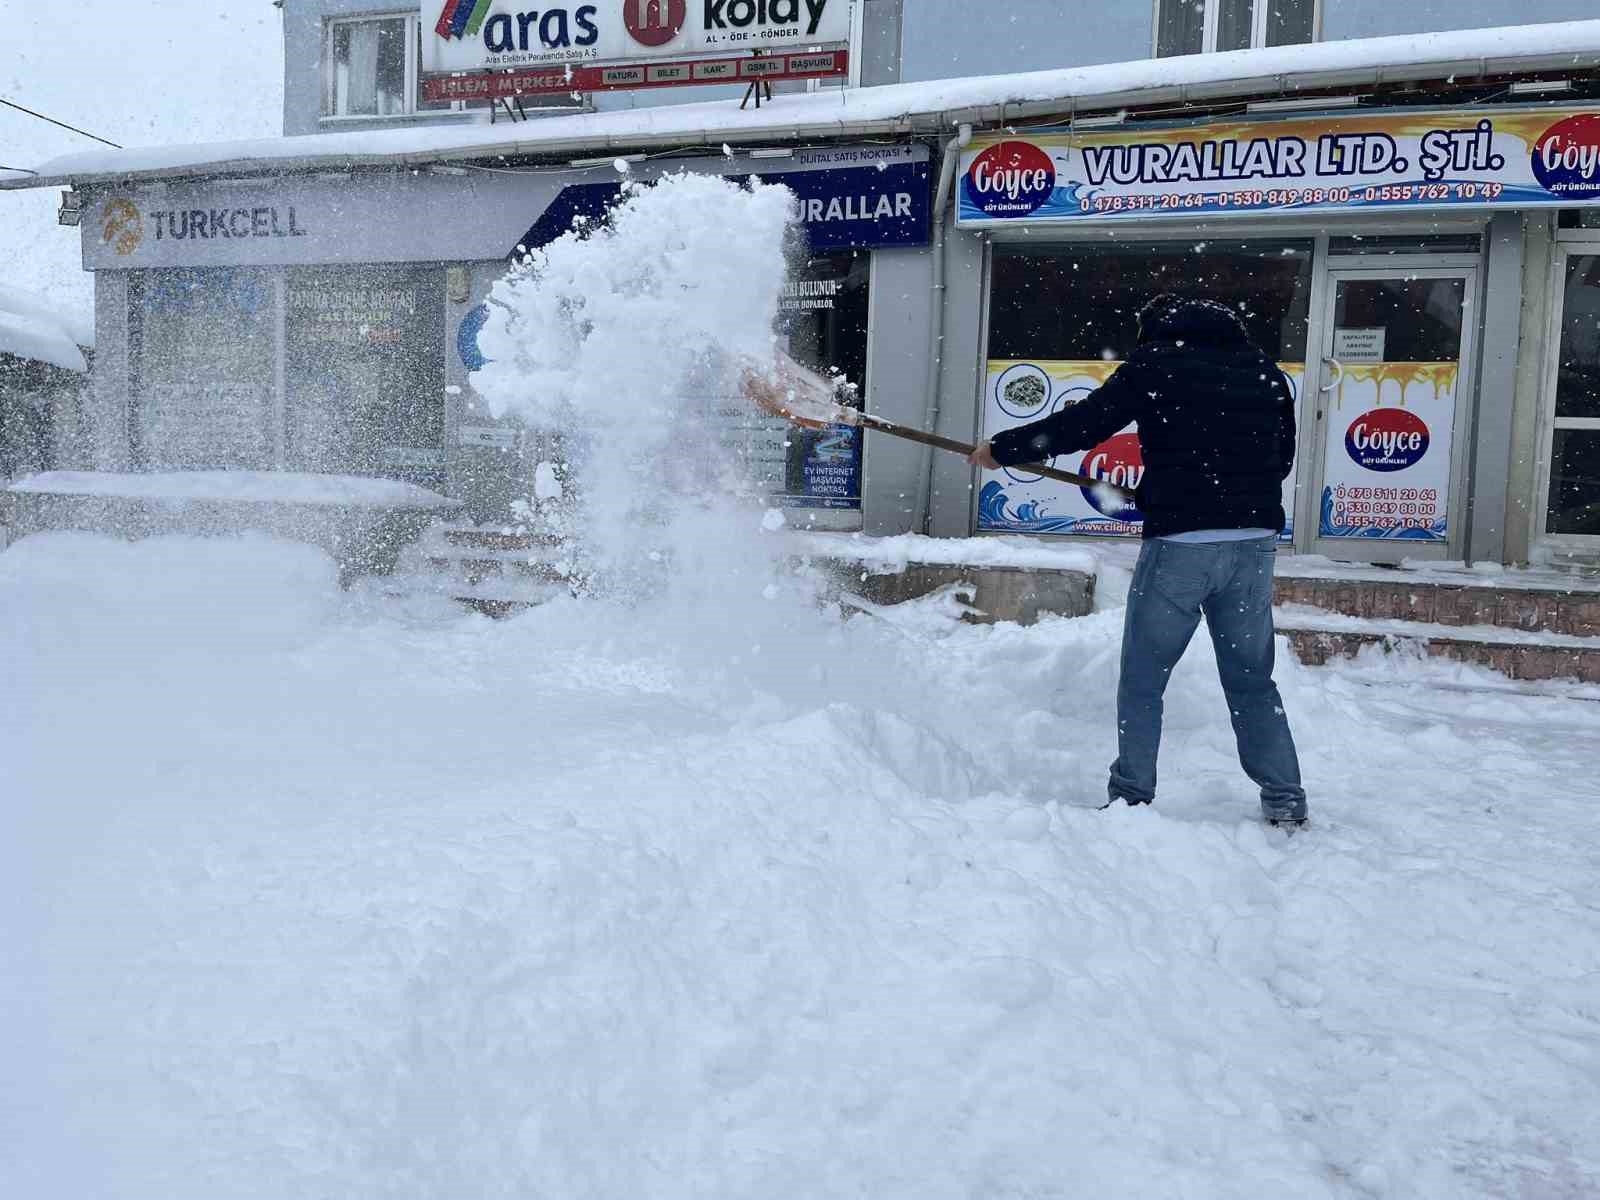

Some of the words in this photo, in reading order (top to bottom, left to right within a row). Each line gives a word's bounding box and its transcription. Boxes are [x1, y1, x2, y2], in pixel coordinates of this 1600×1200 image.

[484, 5, 599, 53] aras
[730, 31, 748, 41] ÖDE
[760, 29, 799, 39] GÖNDER
[486, 56, 500, 64] Aras
[791, 57, 833, 70] BAŞVURU
[607, 71, 639, 80] FATURA
[834, 151, 857, 161] SATIŞ
[1082, 136, 1305, 185] VURALLAR
[1316, 132, 1409, 176] LTD.
[1419, 119, 1505, 181] ŞTİ.
[1542, 135, 1600, 179] Göy
[975, 160, 1047, 200] Göyçe
[1551, 182, 1567, 191] SÜT
[1080, 197, 1089, 211] 0
[1095, 195, 1122, 210] 478
[1127, 194, 1155, 209] 311
[1160, 193, 1179, 208] 20
[1184, 192, 1203, 207] 64
[1218, 192, 1228, 206] 0
[1233, 191, 1262, 205] 530
[1268, 190, 1297, 204] 849
[1303, 188, 1323, 203] 88
[1328, 187, 1349, 201] 00
[1365, 186, 1375, 200] 0
[1381, 185, 1412, 200] 555
[1418, 185, 1448, 199] 762
[1455, 184, 1476, 198] 10
[1481, 183, 1503, 197] 49
[984, 202, 998, 211] SÜT
[150, 206, 307, 240] TURKCELL
[800, 280, 836, 296] BULUNUR
[1353, 423, 1421, 459] Göyçe
[1337, 487, 1346, 499] 0
[1348, 487, 1372, 499] 478
[1374, 488, 1397, 499] 311
[1400, 489, 1418, 500] 20
[1420, 489, 1437, 500] 64
[1336, 502, 1344, 513] 0
[1347, 502, 1371, 513] 530
[1374, 503, 1397, 514] 849
[1400, 503, 1416, 514] 88
[1419, 504, 1436, 515] 00
[1335, 515, 1344, 527] 0
[1346, 516, 1370, 528] 555
[1371, 517, 1396, 528] 762
[1400, 518, 1415, 529] 10
[1419, 518, 1434, 529] 49
